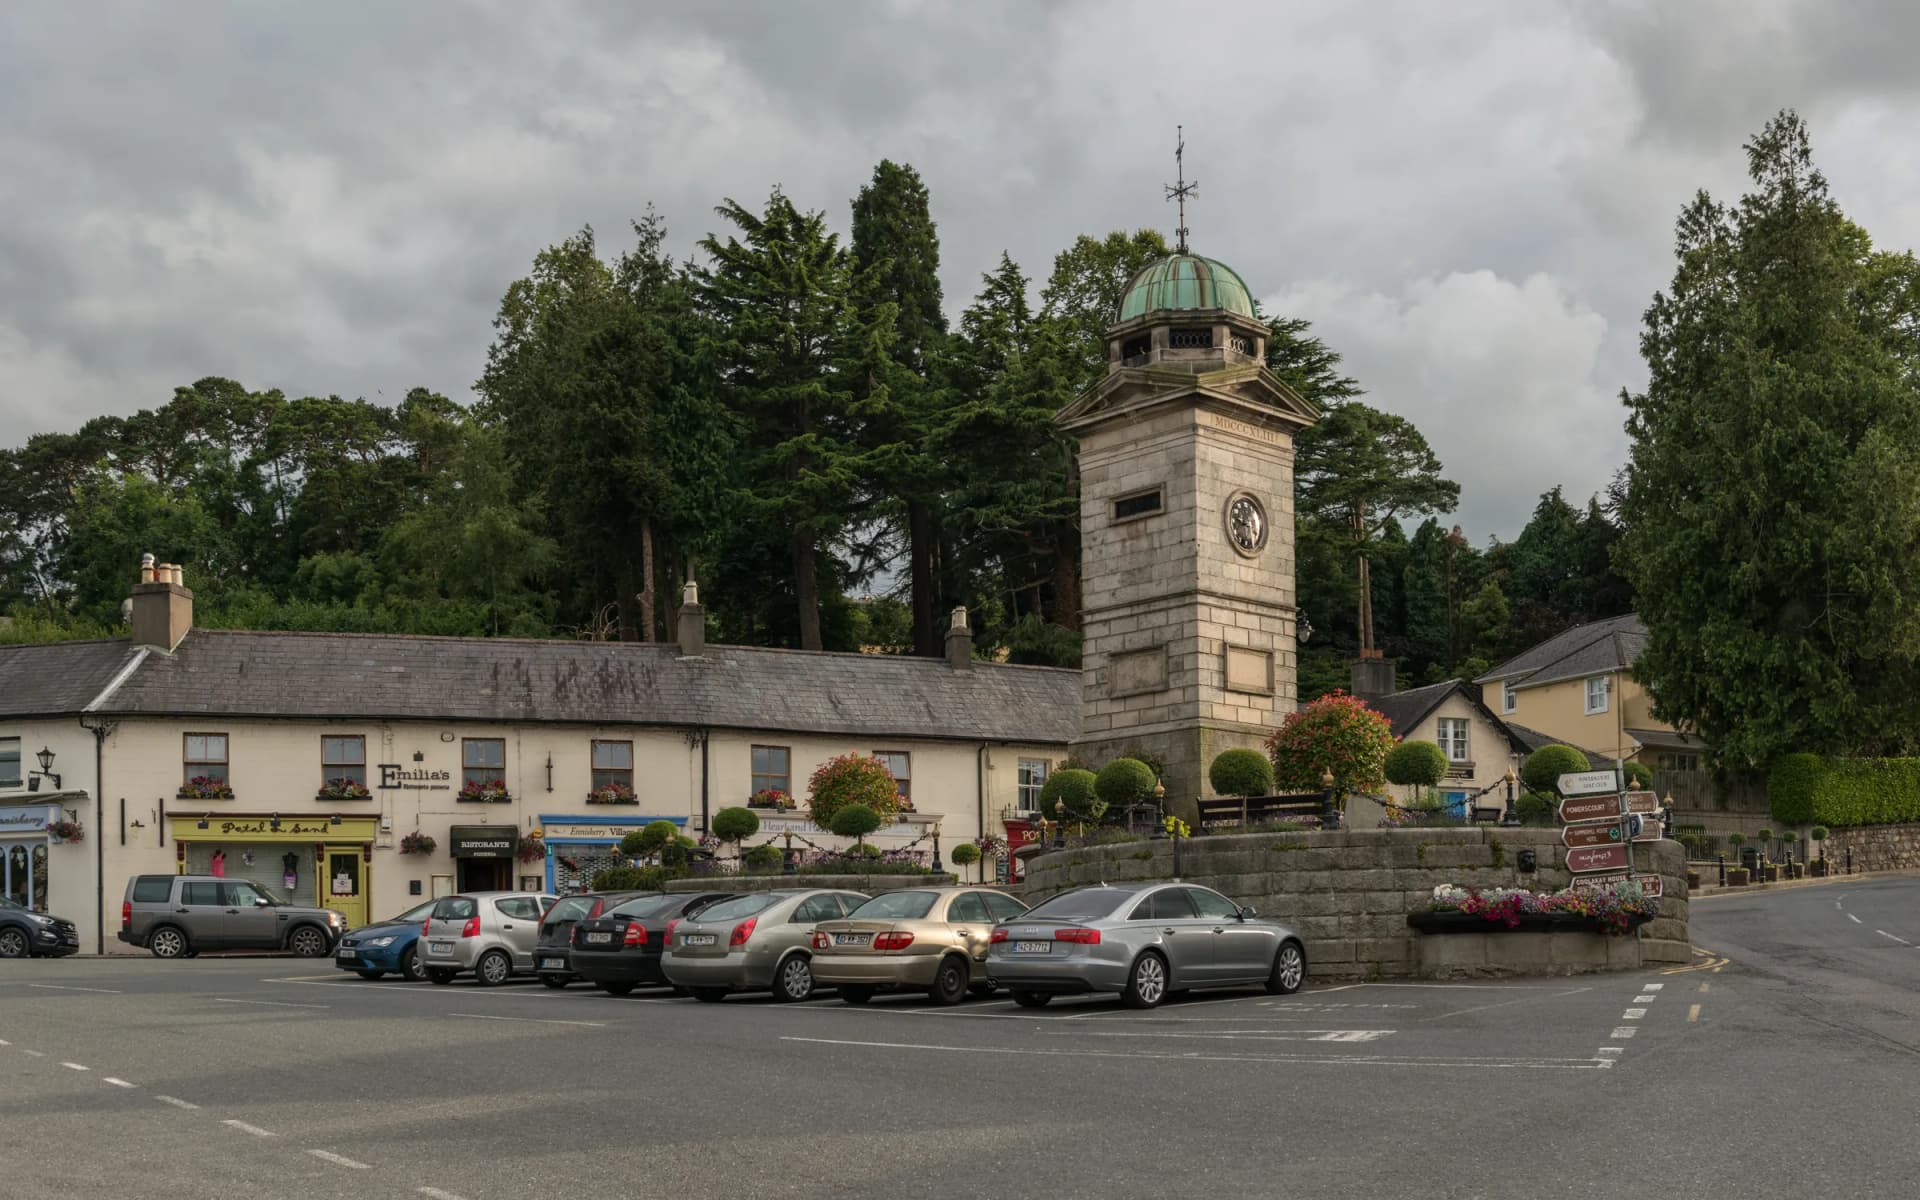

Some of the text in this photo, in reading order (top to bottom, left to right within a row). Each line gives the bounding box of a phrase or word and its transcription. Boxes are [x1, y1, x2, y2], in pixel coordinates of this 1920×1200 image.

[378, 764, 450, 789] Emilia's
[1566, 804, 1605, 813] POWERSCOURT
[221, 822, 266, 833] Petal
[461, 841, 510, 849] RISTORANTE
